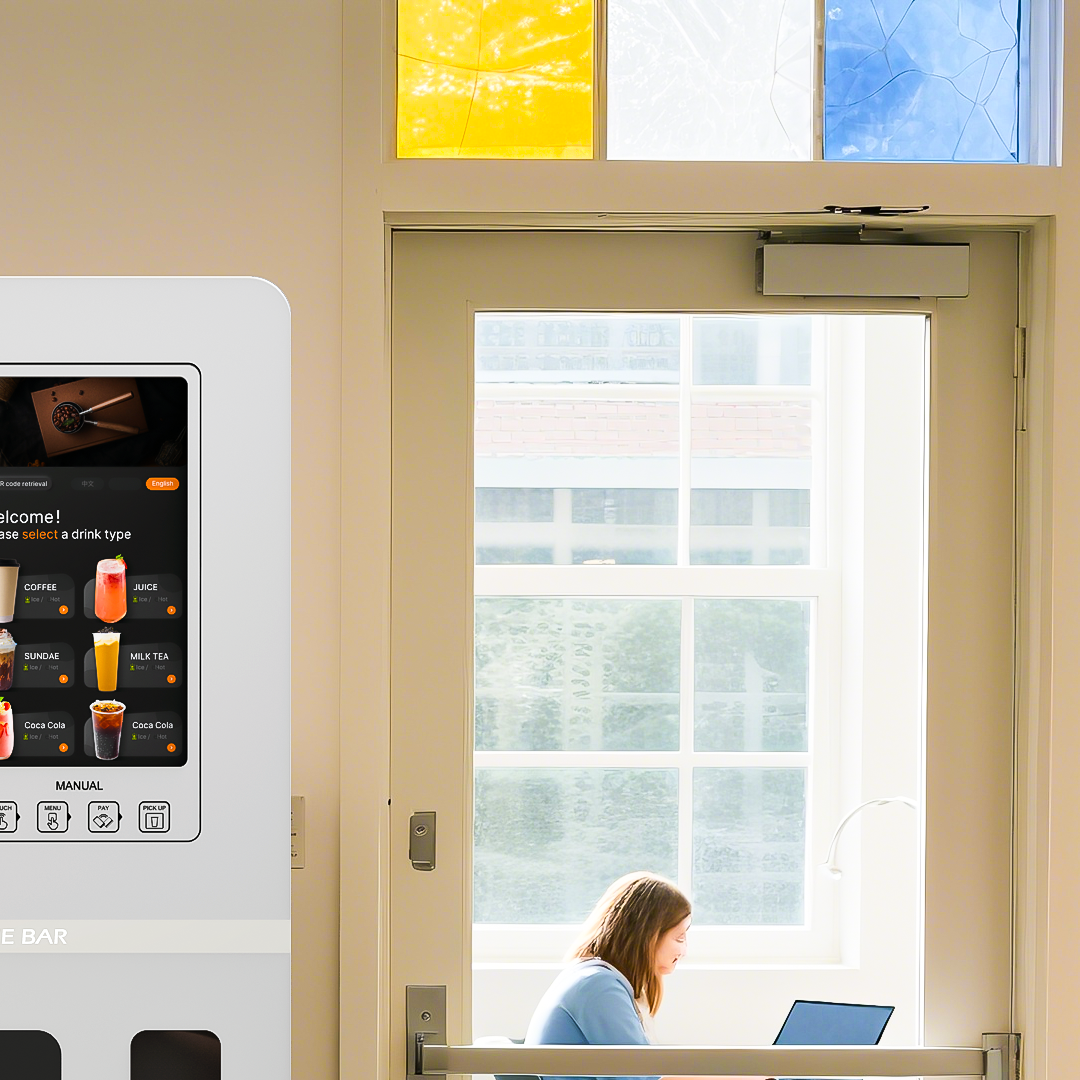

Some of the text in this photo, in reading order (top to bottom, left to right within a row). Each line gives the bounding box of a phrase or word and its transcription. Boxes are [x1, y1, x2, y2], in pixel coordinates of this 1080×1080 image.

[81, 480, 95, 488] 中文
[151, 480, 174, 488] English
[22, 528, 59, 540] select
[61, 530, 69, 540] a
[71, 528, 102, 540] drink
[104, 529, 132, 542] type
[23, 583, 57, 591] COFFEE
[133, 583, 158, 591] JUICE
[24, 652, 60, 660] SUNDAE
[130, 652, 169, 661] MILK TEA
[24, 721, 66, 730] Coca Cola
[132, 721, 174, 729] Coca Cola
[55, 780, 104, 791] MANUAL
[20, 927, 68, 946] BAR
